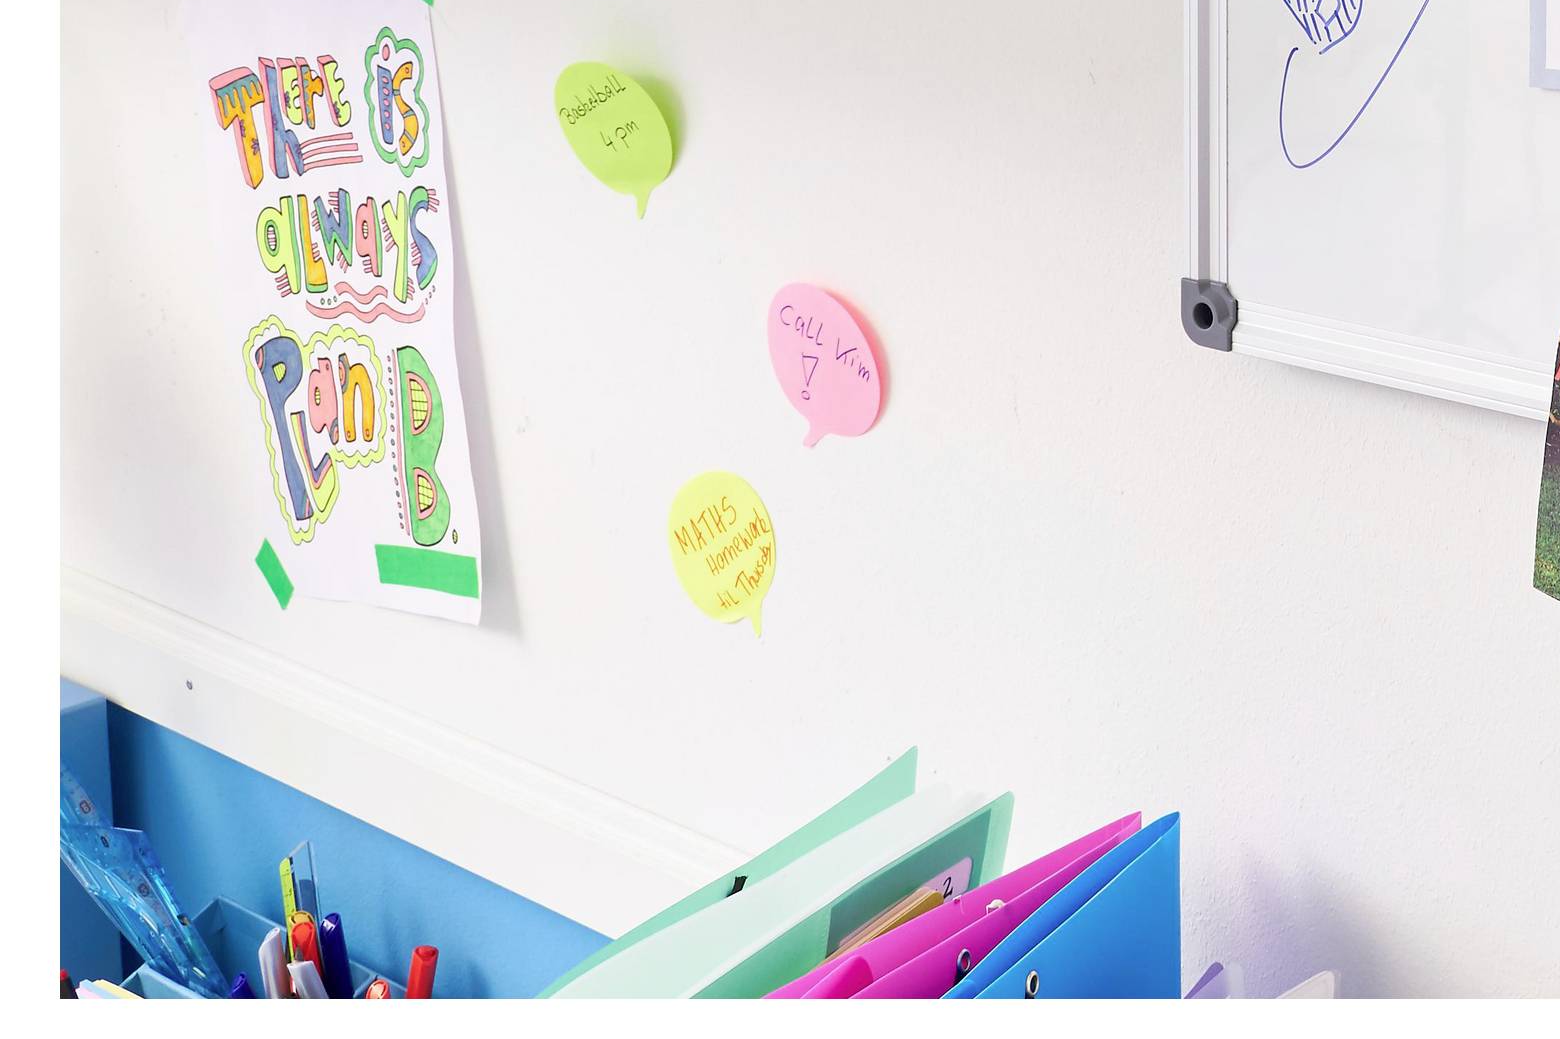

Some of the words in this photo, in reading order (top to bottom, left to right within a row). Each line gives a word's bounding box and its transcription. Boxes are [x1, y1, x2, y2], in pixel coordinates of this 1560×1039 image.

[600, 131, 617, 152] 4
[674, 496, 737, 555] MATHS
[943, 876, 954, 899] 2
